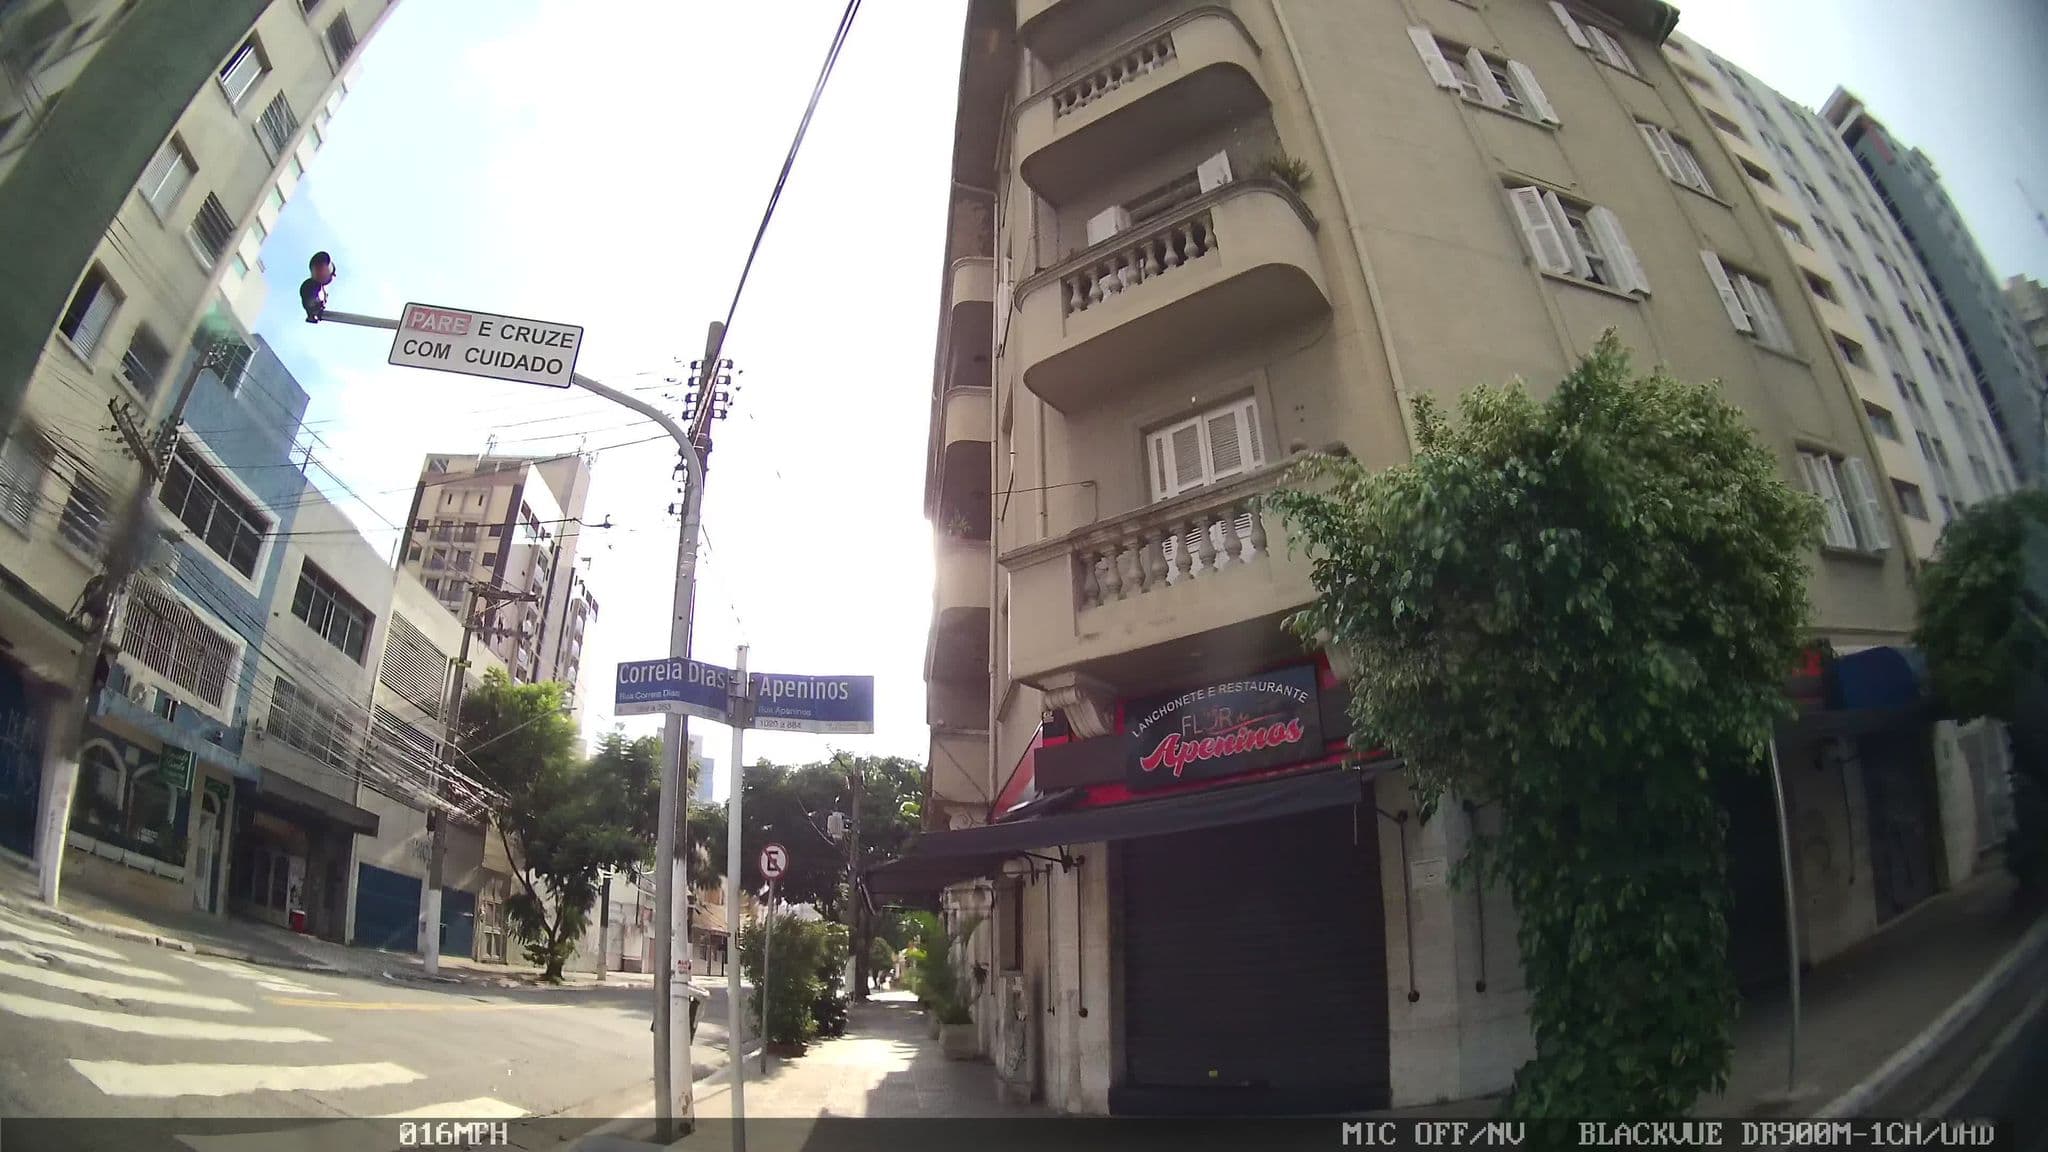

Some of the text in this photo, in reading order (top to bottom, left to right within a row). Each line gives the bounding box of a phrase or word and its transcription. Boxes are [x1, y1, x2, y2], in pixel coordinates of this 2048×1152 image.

[411, 311, 575, 349] PARE E CRUZE
[403, 339, 564, 375] COM CUIDADO
[618, 660, 726, 689] Correia Dias
[759, 677, 849, 702] Apeninos
[1131, 680, 1309, 738] LANCHONETE E RESTAURANTE
[1140, 716, 1304, 778] Apeninos
